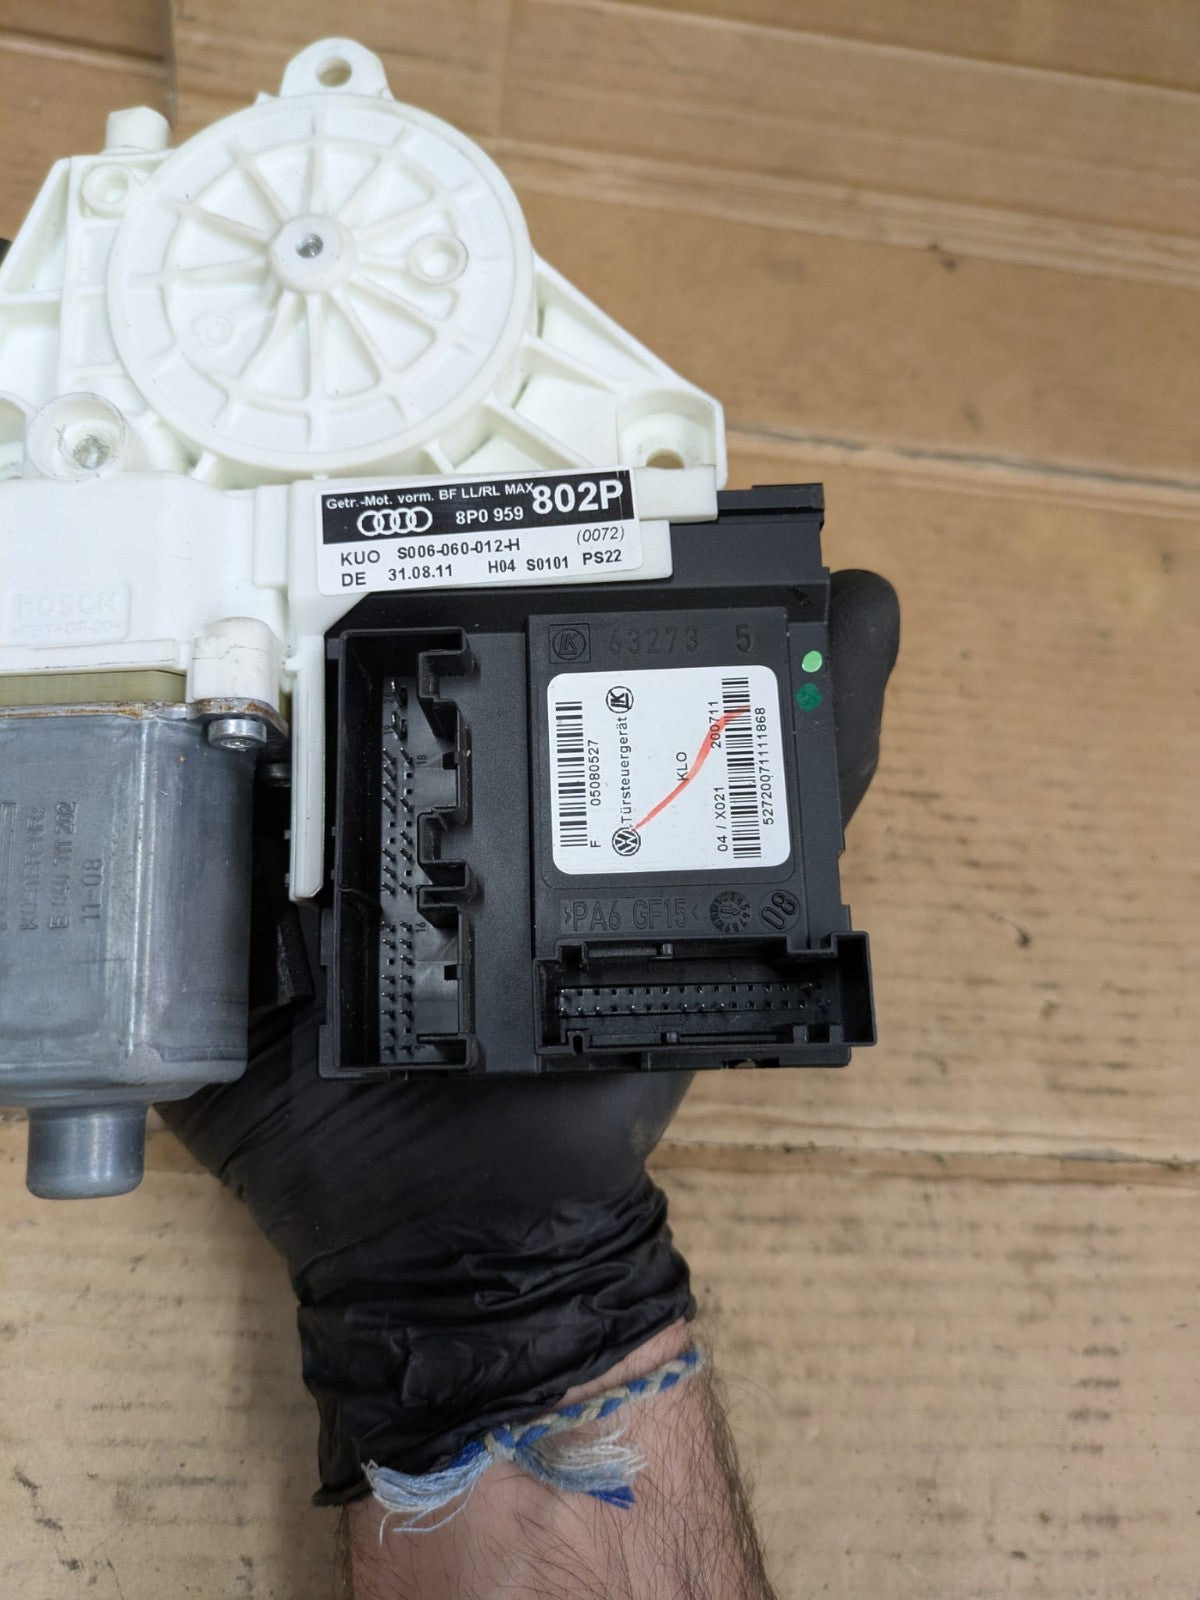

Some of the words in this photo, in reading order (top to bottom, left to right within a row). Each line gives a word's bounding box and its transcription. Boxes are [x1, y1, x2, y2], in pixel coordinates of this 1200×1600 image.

[326, 495, 393, 510] Getr.-Mot.
[397, 492, 434, 504] vorm.
[438, 488, 457, 501] BF
[461, 485, 501, 499] LL/RL
[504, 482, 534, 495] MAX
[455, 509, 489, 525] 8P0
[493, 506, 524, 522] 959
[532, 479, 624, 515] 802P
[340, 549, 381, 567] KUO
[397, 538, 521, 560] S006-060-012-H
[576, 526, 625, 545] (0072)
[341, 571, 366, 587] DE
[388, 564, 453, 581] 31.08.11
[488, 559, 516, 574] H04
[526, 556, 569, 571] S0101
[582, 549, 623, 565] PS22
[608, 624, 700, 655] 63273
[735, 623, 754, 653] 5
[708, 700, 722, 749] 200711
[587, 738, 602, 807] 05080527
[616, 716, 632, 824] Türsteuergerät
[675, 751, 689, 782] KLO
[754, 707, 775, 826] 52720071111868
[713, 787, 727, 820] X021
[589, 839, 602, 848] F
[717, 835, 729, 852] 04
[49, 913, 70, 930] E
